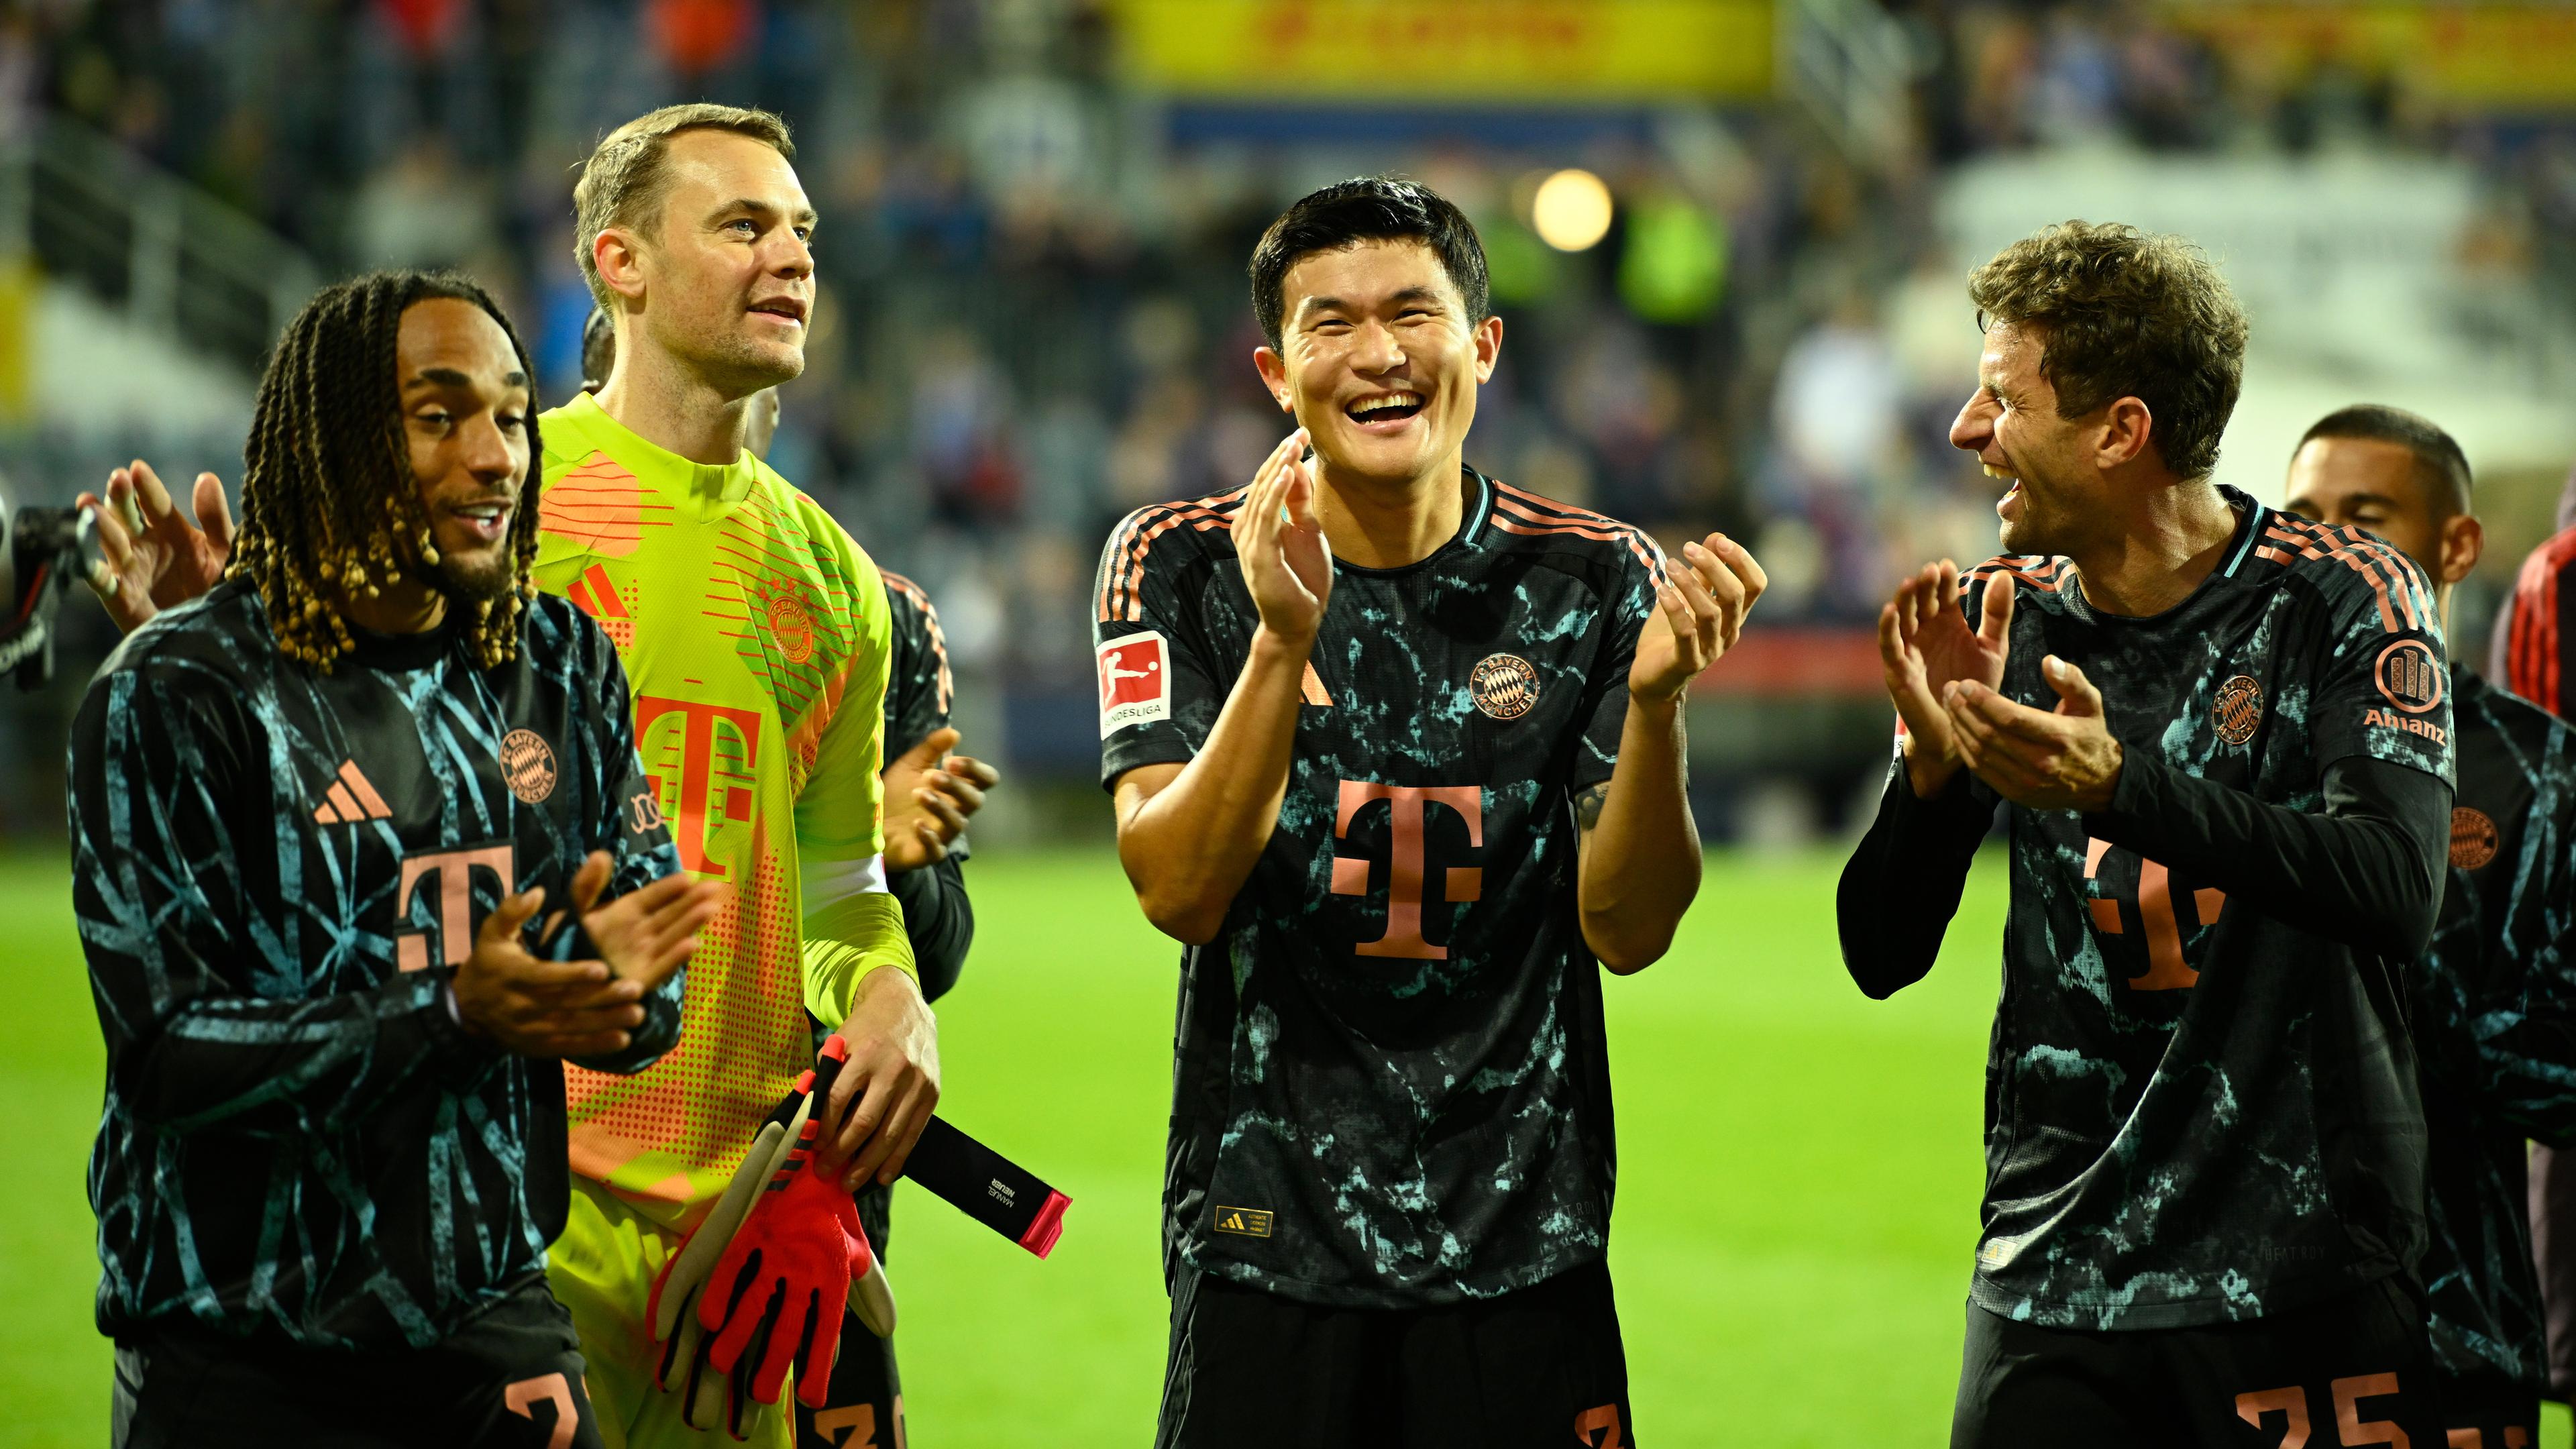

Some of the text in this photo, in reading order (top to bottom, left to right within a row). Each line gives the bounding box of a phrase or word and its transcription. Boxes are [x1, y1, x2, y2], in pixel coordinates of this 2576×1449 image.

[1474, 657, 1533, 683] FC BAYERN
[2223, 680, 2258, 696] BAYERN
[1476, 692, 1534, 716] MÜNCHEN
[1106, 705, 1161, 729] UNDESLIGA
[2363, 709, 2446, 746] Allianz
[1330, 780, 1483, 960] T
[987, 1186, 1014, 1208] MANUEL
[991, 1178, 1015, 1197] NEUER
[2235, 1372, 2410, 1449] 25
